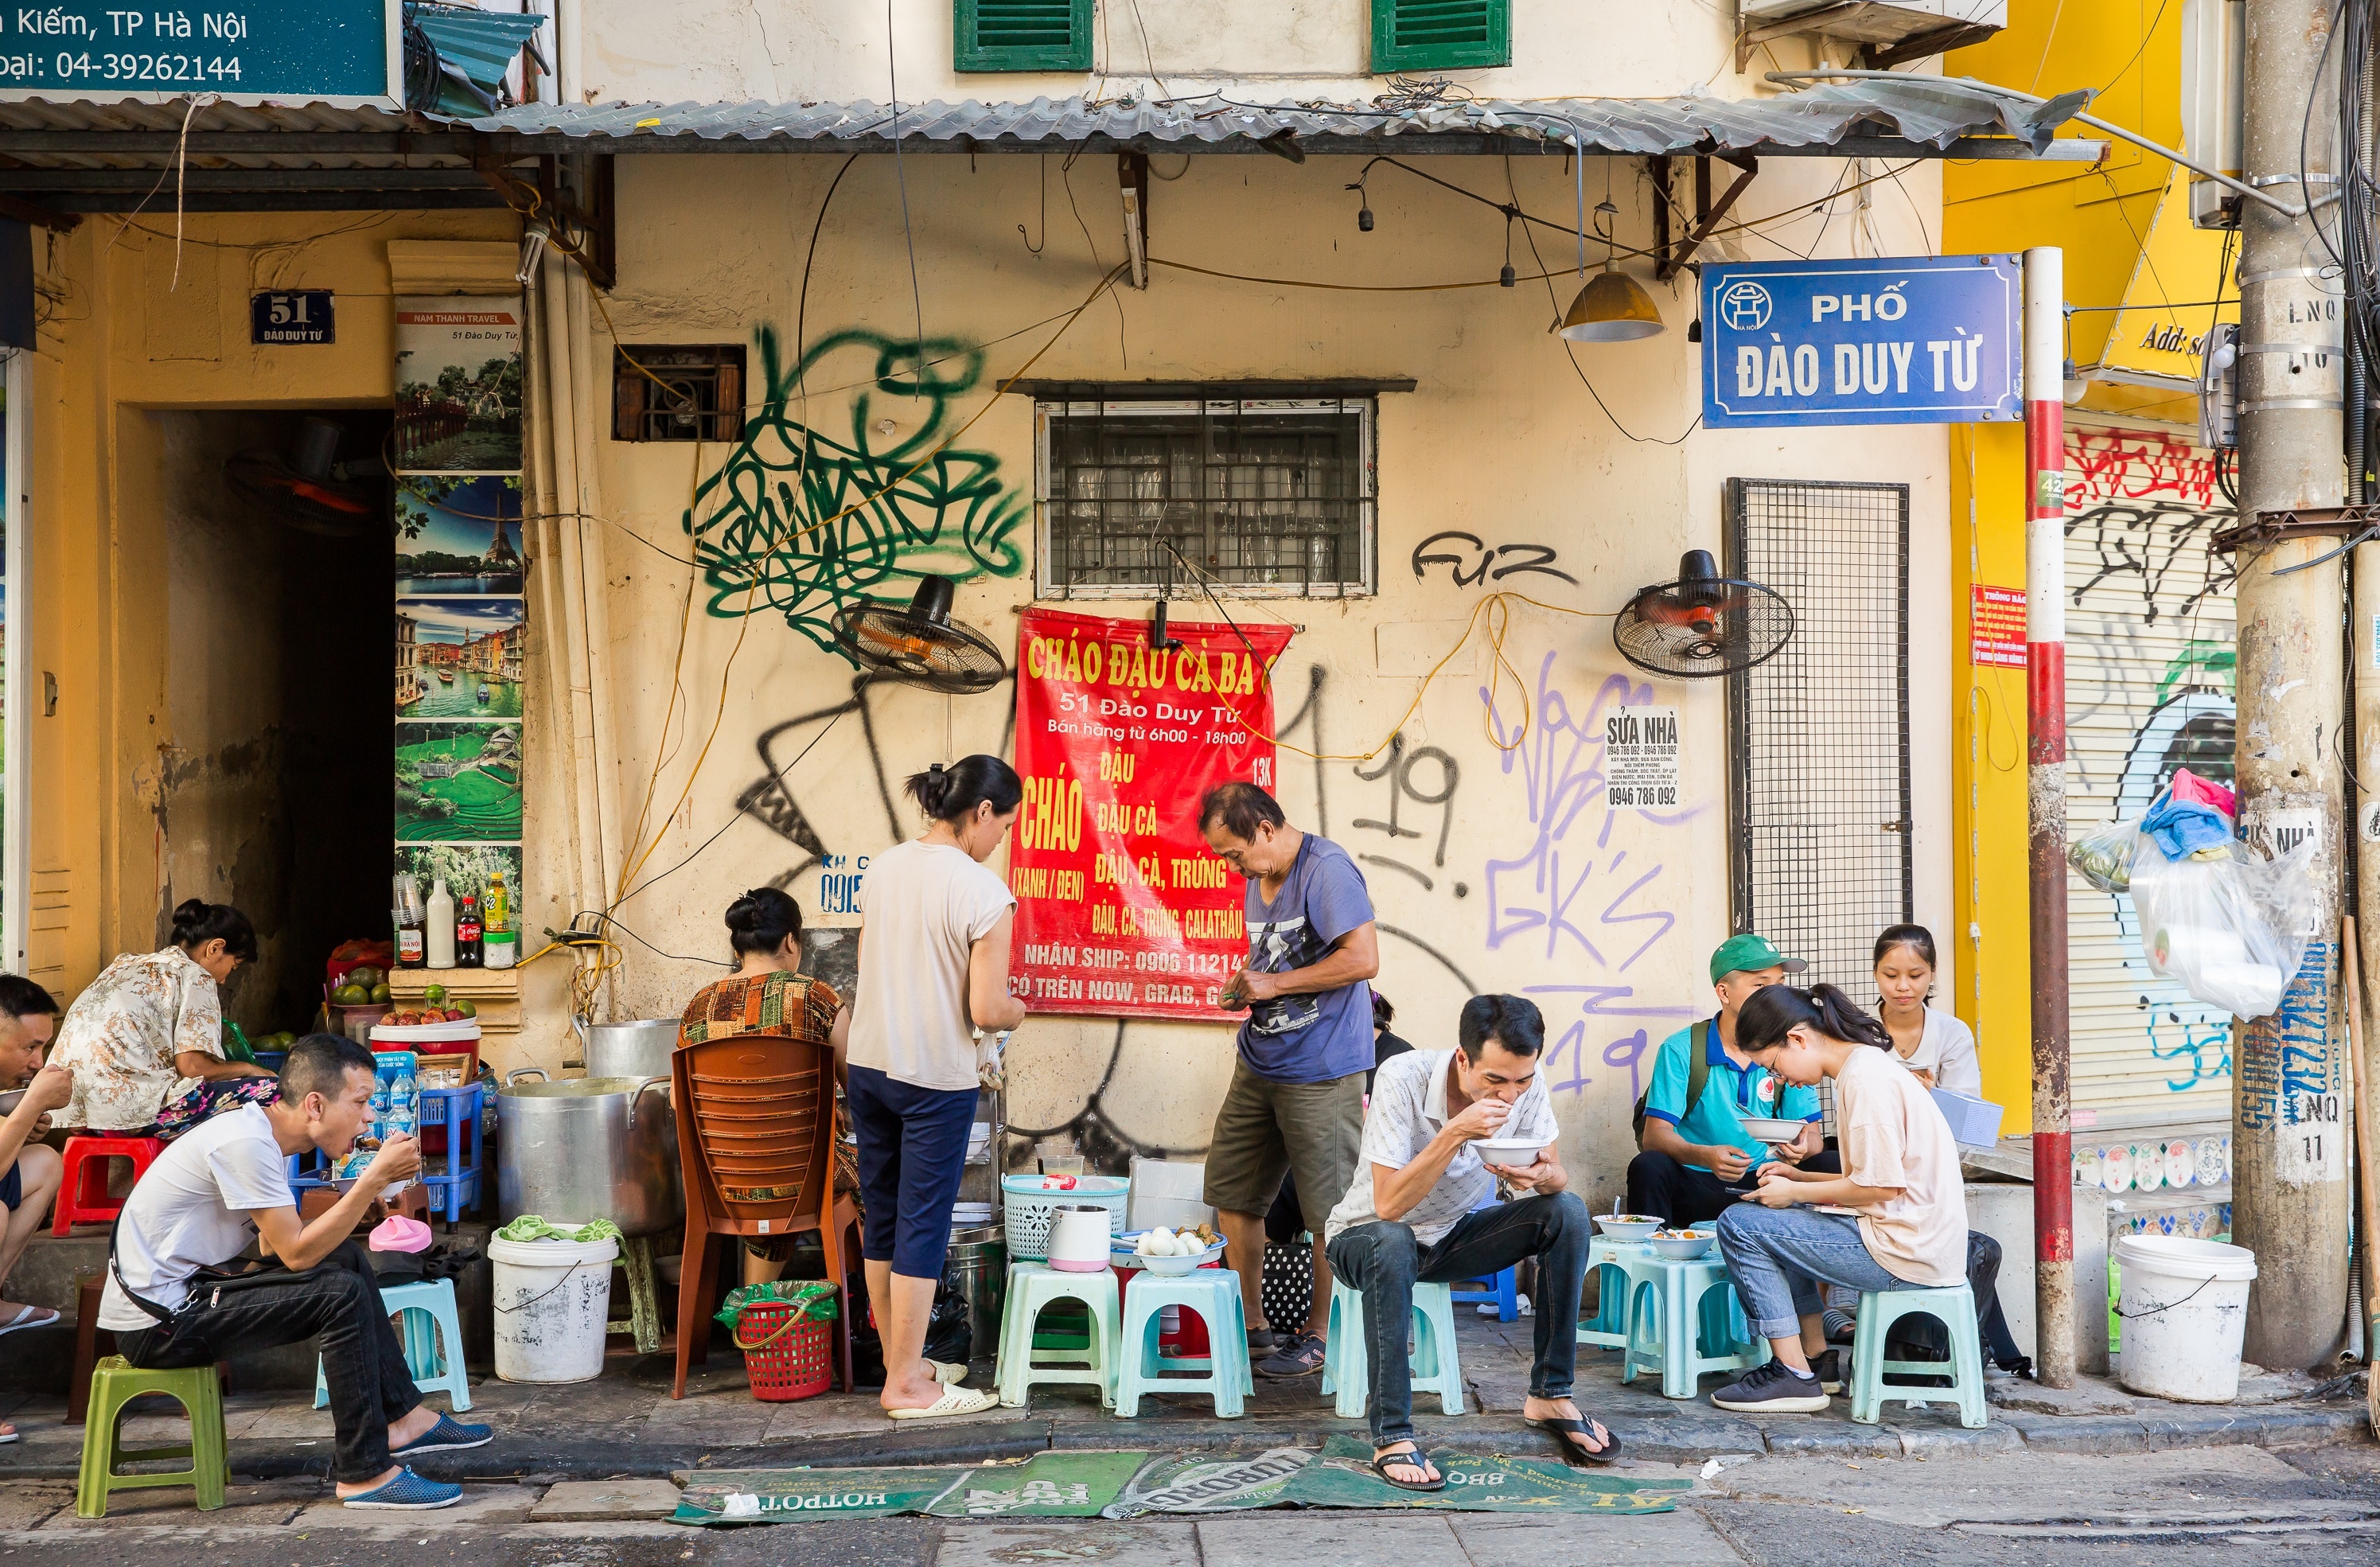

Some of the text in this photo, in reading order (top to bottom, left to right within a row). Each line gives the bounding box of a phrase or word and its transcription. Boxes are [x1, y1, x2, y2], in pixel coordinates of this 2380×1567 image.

[18, 6, 98, 41] Kiếm,
[106, 10, 143, 37] TP
[154, 10, 192, 38] Hà
[203, 11, 247, 43] Nội
[56, 52, 242, 81] 04-39262144
[269, 294, 312, 324] 51
[1812, 279, 1910, 323] PHỐ
[263, 327, 323, 341] ĐÀO DUY TỪ
[414, 314, 500, 324] NAM THANH TRAVEL
[452, 331, 463, 340] 51
[465, 331, 483, 341] Đào
[484, 332, 502, 342] Duy
[2139, 322, 2187, 353] Add:
[1735, 325, 1984, 397] ĐÀO DUY TỪ
[1985, 591, 2011, 602] THÔNG
[1027, 627, 1102, 684] CHÁO
[1108, 633, 1170, 698] ĐẬU
[1175, 637, 1212, 693] CÀ
[1059, 692, 1089, 714] 51
[1100, 697, 1148, 719] Đào
[1155, 703, 1204, 726] Duy
[1607, 705, 1678, 745] SỬA NHÀ
[1047, 719, 1078, 734] Bán
[1082, 721, 1125, 742] hàng
[1129, 726, 1144, 740] từ
[1149, 727, 1187, 743] 6h00
[1204, 730, 1247, 746] 18h00
[1644, 745, 1657, 755] 0946
[1657, 746, 1667, 754] 786
[1667, 746, 1677, 754] 092
[1099, 746, 1272, 789] ĐẬU 13K
[1019, 762, 1083, 853] CHÁO
[1609, 786, 1676, 805] 0946 786 092
[1097, 797, 1157, 840] ĐẬU CÀ
[1012, 867, 1046, 899] (XANH
[1056, 869, 1085, 904] ĐEN)
[1094, 848, 1227, 891] ĐẬU, CÀ, TRỨNG
[1092, 898, 1118, 941] ĐẬU,
[1121, 900, 1140, 939] CÀ,
[1143, 900, 1183, 943] TRỨNG,
[1024, 941, 1077, 970] NHẬN
[1081, 946, 1130, 970] SHIP:
[1135, 952, 1181, 973] 0906
[1034, 975, 1083, 1000] TRÊN
[1088, 980, 1138, 1005] NOW,
[1144, 983, 1200, 1007] GRAB,
[2303, 1134, 2322, 1162] 11
[1447, 1470, 1507, 1486] BBQ
[761, 1492, 888, 1511] HOTPOT
